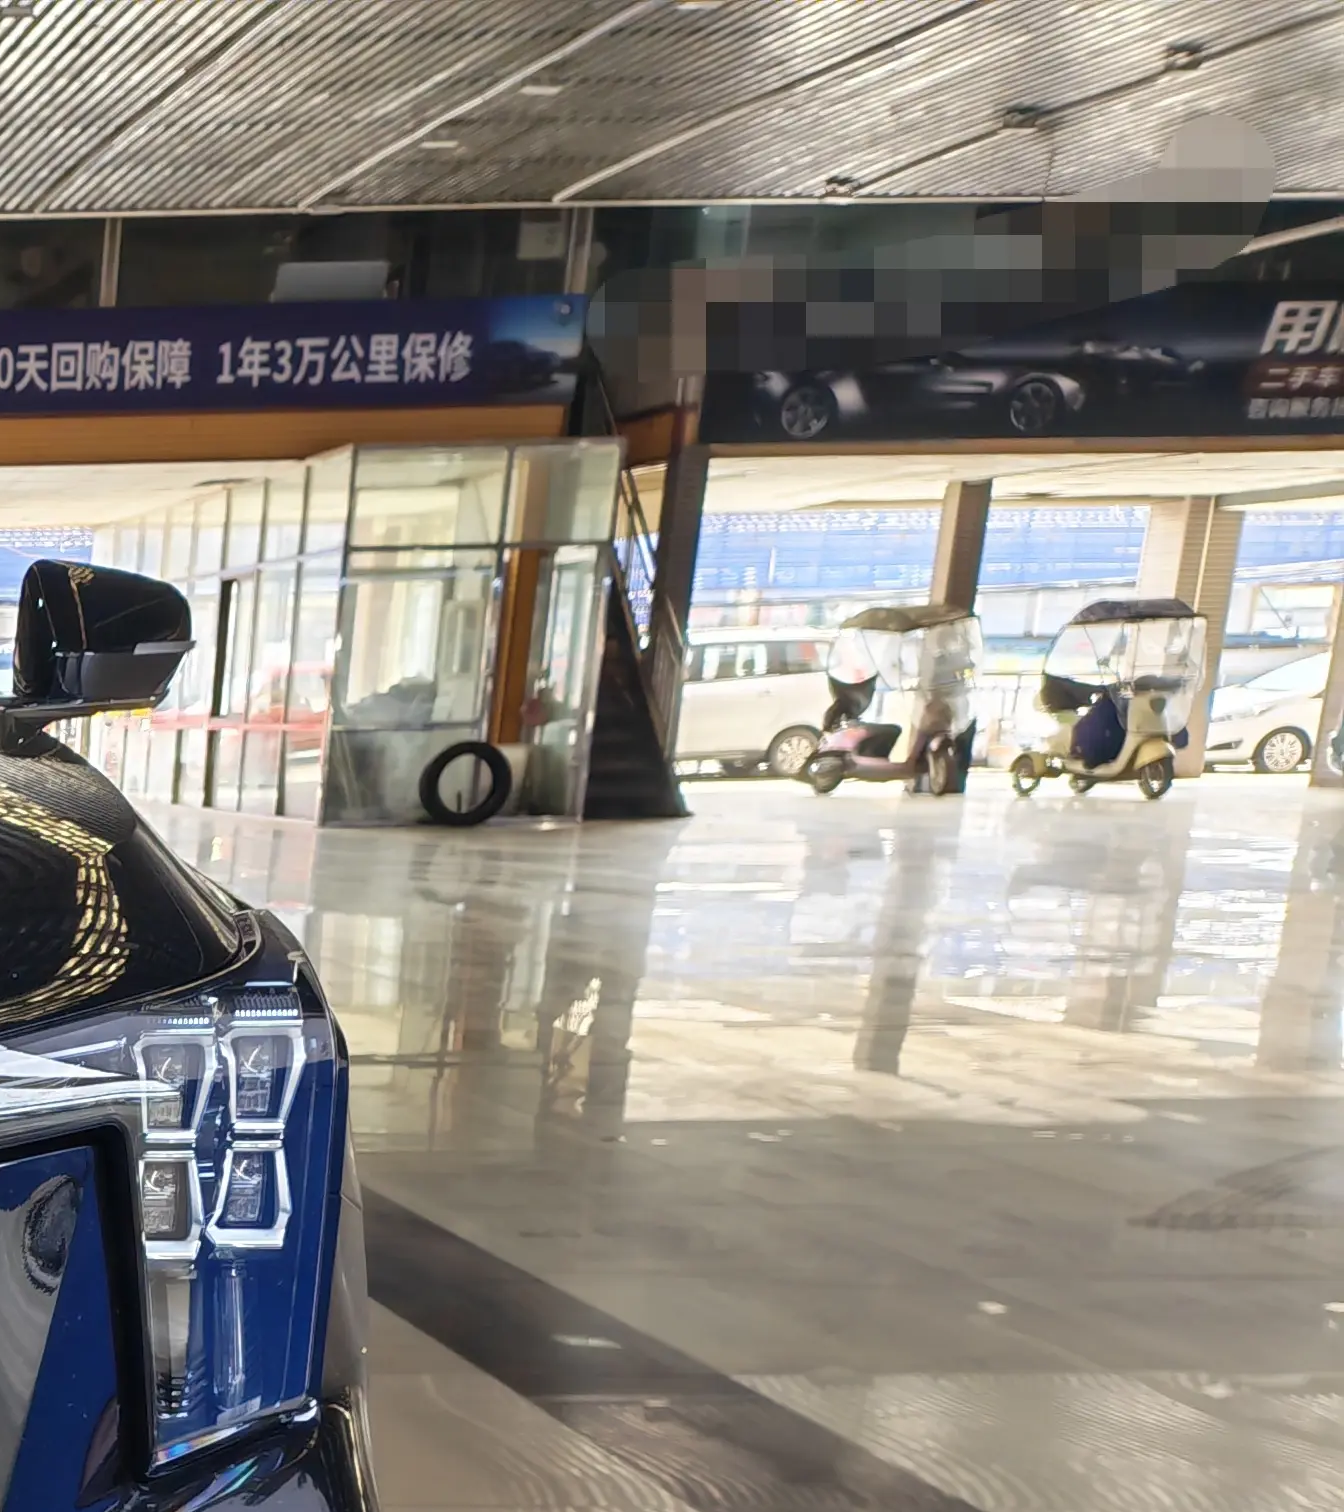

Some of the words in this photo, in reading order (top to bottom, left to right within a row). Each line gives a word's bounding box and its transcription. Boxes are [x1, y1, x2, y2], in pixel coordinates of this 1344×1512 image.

[1260, 300, 1344, 354] 用
[216, 331, 473, 388] 1年3万公里保修
